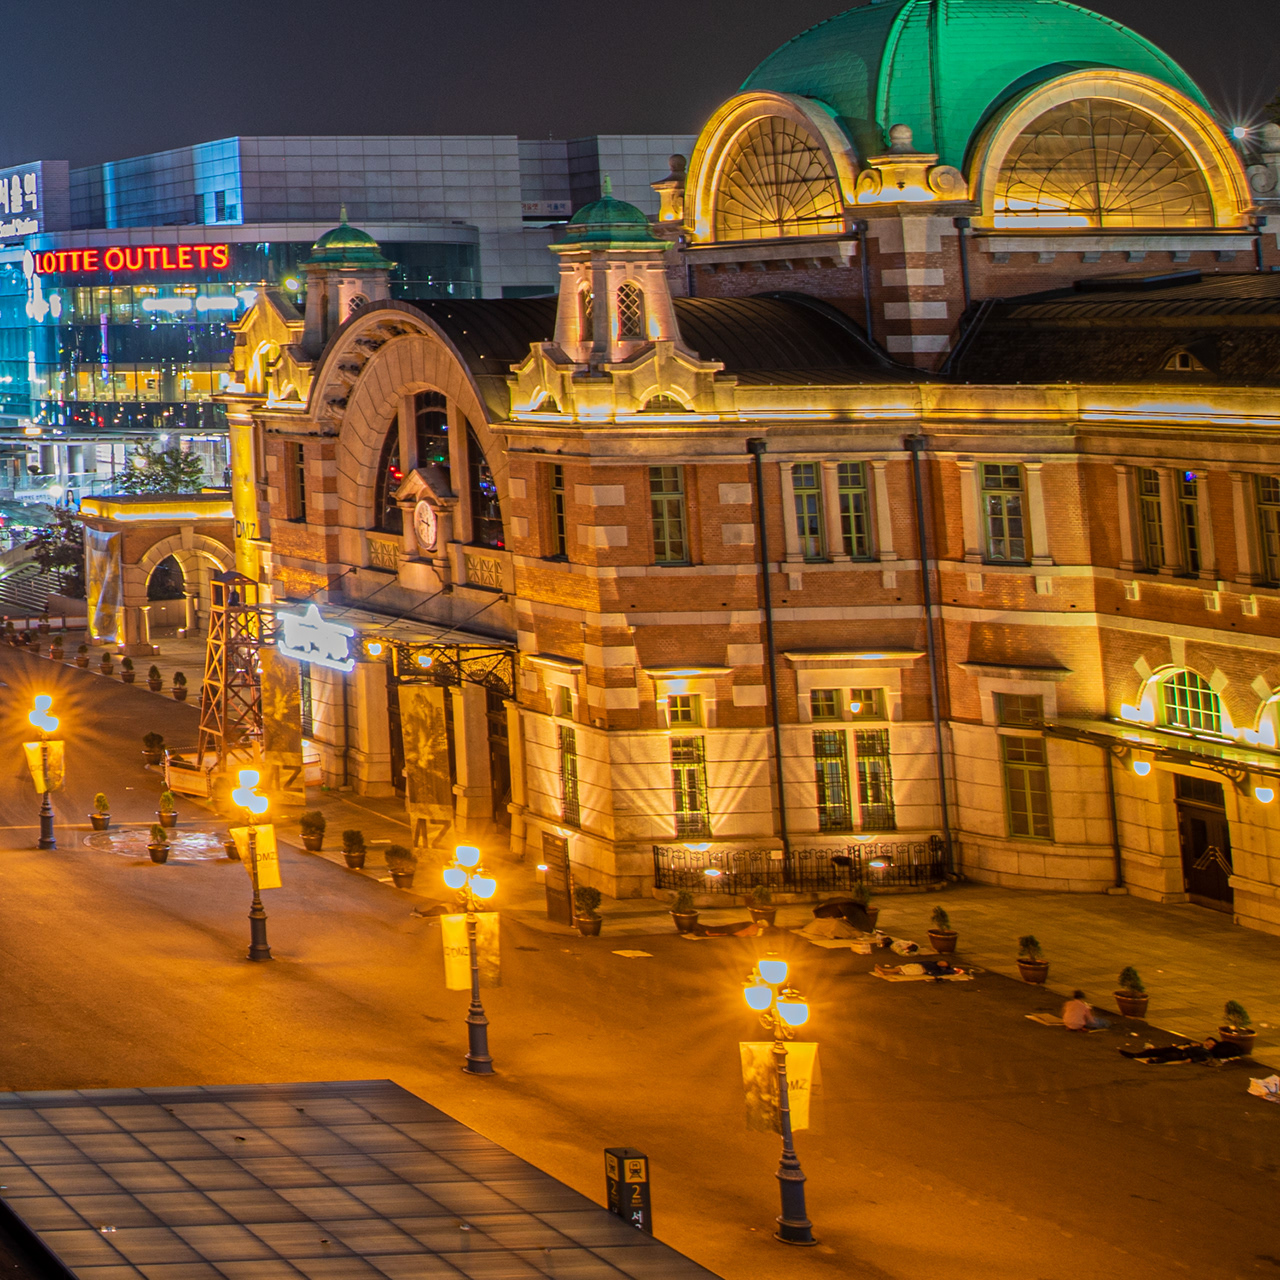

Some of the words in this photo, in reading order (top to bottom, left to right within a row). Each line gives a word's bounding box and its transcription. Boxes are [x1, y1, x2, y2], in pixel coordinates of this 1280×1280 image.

[16, 218, 40, 236] Station
[35, 249, 99, 273] LOTTE
[104, 244, 229, 271] OUTLETS
[236, 520, 256, 538] DMZ
[611, 1181, 617, 1195] 2
[632, 1185, 641, 1199] 2
